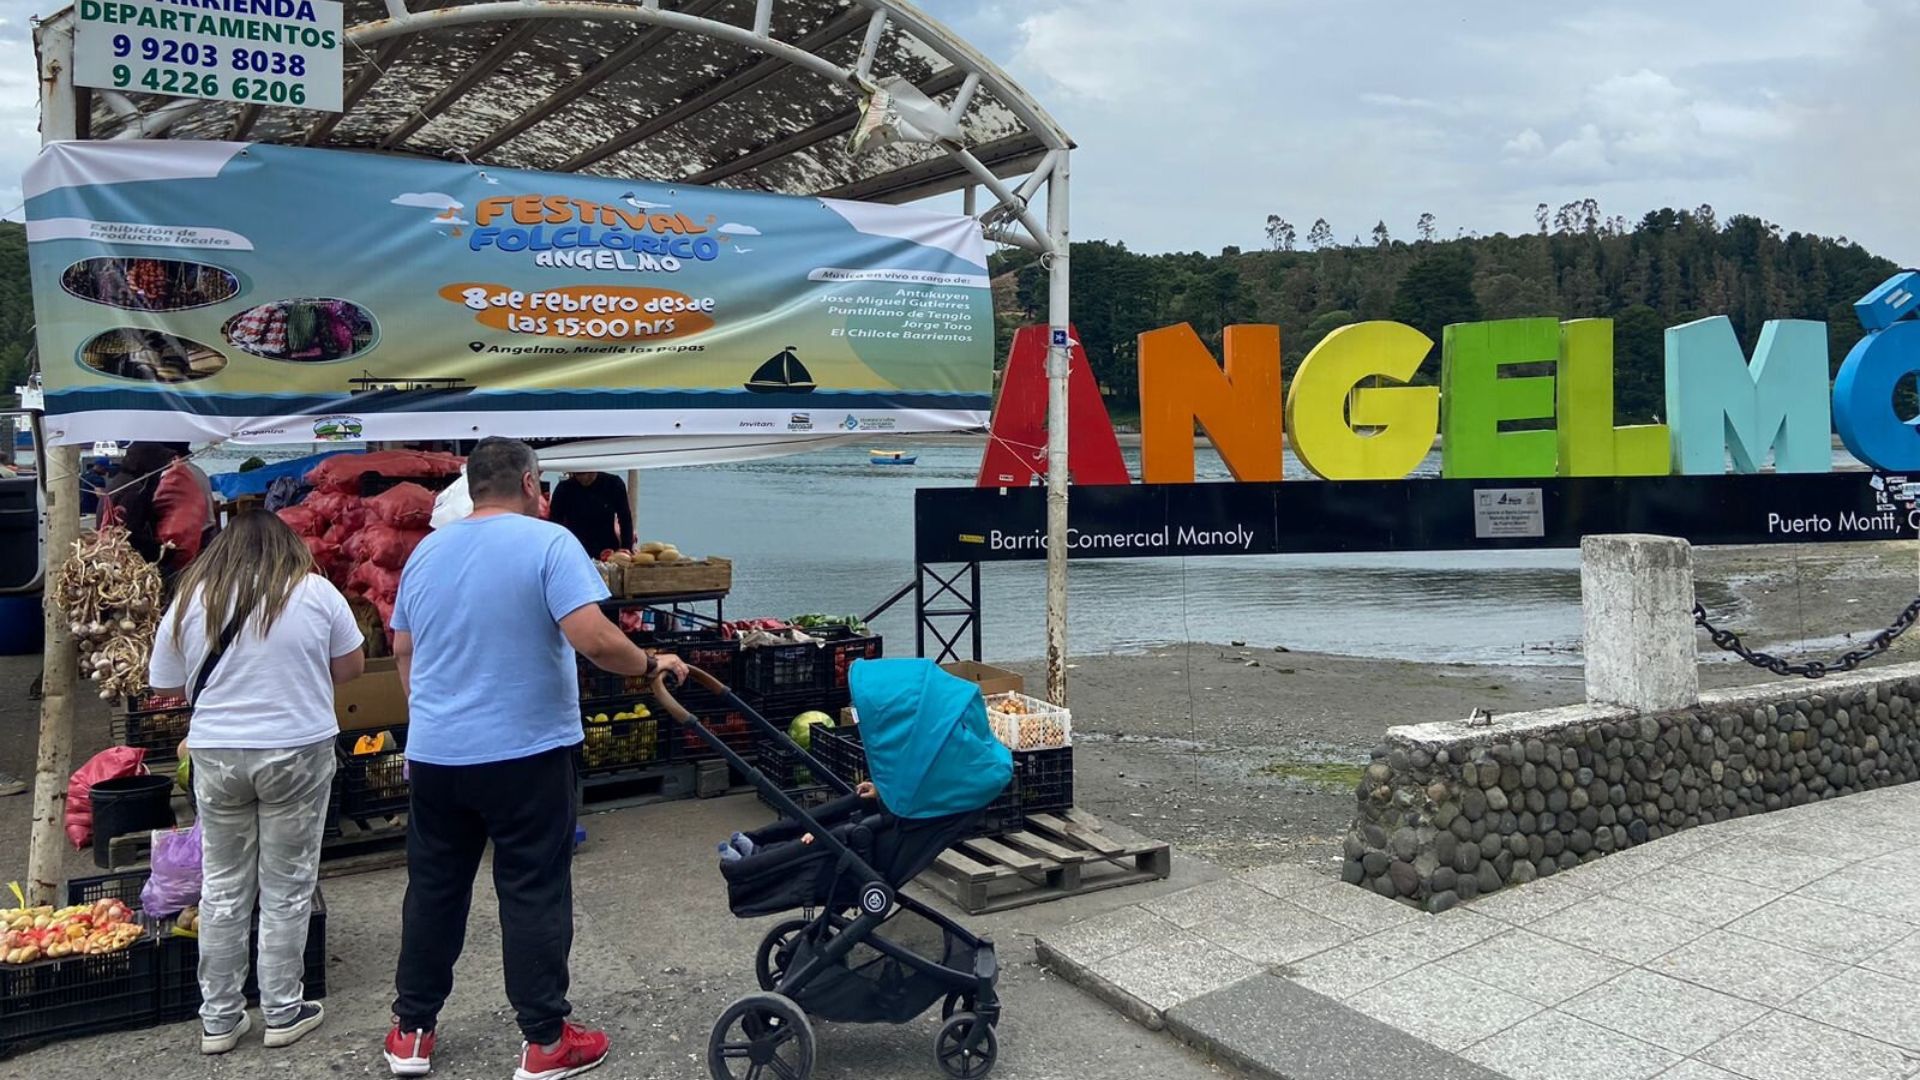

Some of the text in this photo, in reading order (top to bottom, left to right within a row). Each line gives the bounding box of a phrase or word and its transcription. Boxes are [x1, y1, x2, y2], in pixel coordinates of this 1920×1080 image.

[155, 0, 316, 22] IENDA
[81, 0, 336, 49] DEPARTAMENTOS
[113, 34, 306, 77] 9 9203 8038
[112, 64, 306, 105] 9 4226 6206
[476, 193, 707, 234] FESTIVAL
[90, 223, 197, 237] Exhibición de
[90, 231, 231, 246] productos locales
[470, 225, 720, 261] FOLCLÓRICO
[535, 250, 681, 273] ANGELMO
[884, 272, 909, 281] vivo
[921, 274, 951, 284] cargo
[461, 287, 489, 310] 8
[644, 296, 716, 316] desde
[820, 294, 853, 304] Jose
[856, 296, 906, 307] Miguel
[896, 288, 970, 302] Antukuyen
[827, 305, 972, 322] Puntillano de Tenglo
[508, 313, 677, 339] las 15:00 hrs
[830, 328, 974, 342] El Chilote Barrientos
[902, 320, 973, 331] Jorge Toro
[486, 344, 569, 355] Angelmo,
[573, 345, 626, 355] Muelle
[655, 345, 706, 355] papas
[1768, 512, 1832, 534] Puerto
[1838, 510, 1901, 534] Montt,
[1177, 523, 1254, 550] Manoly
